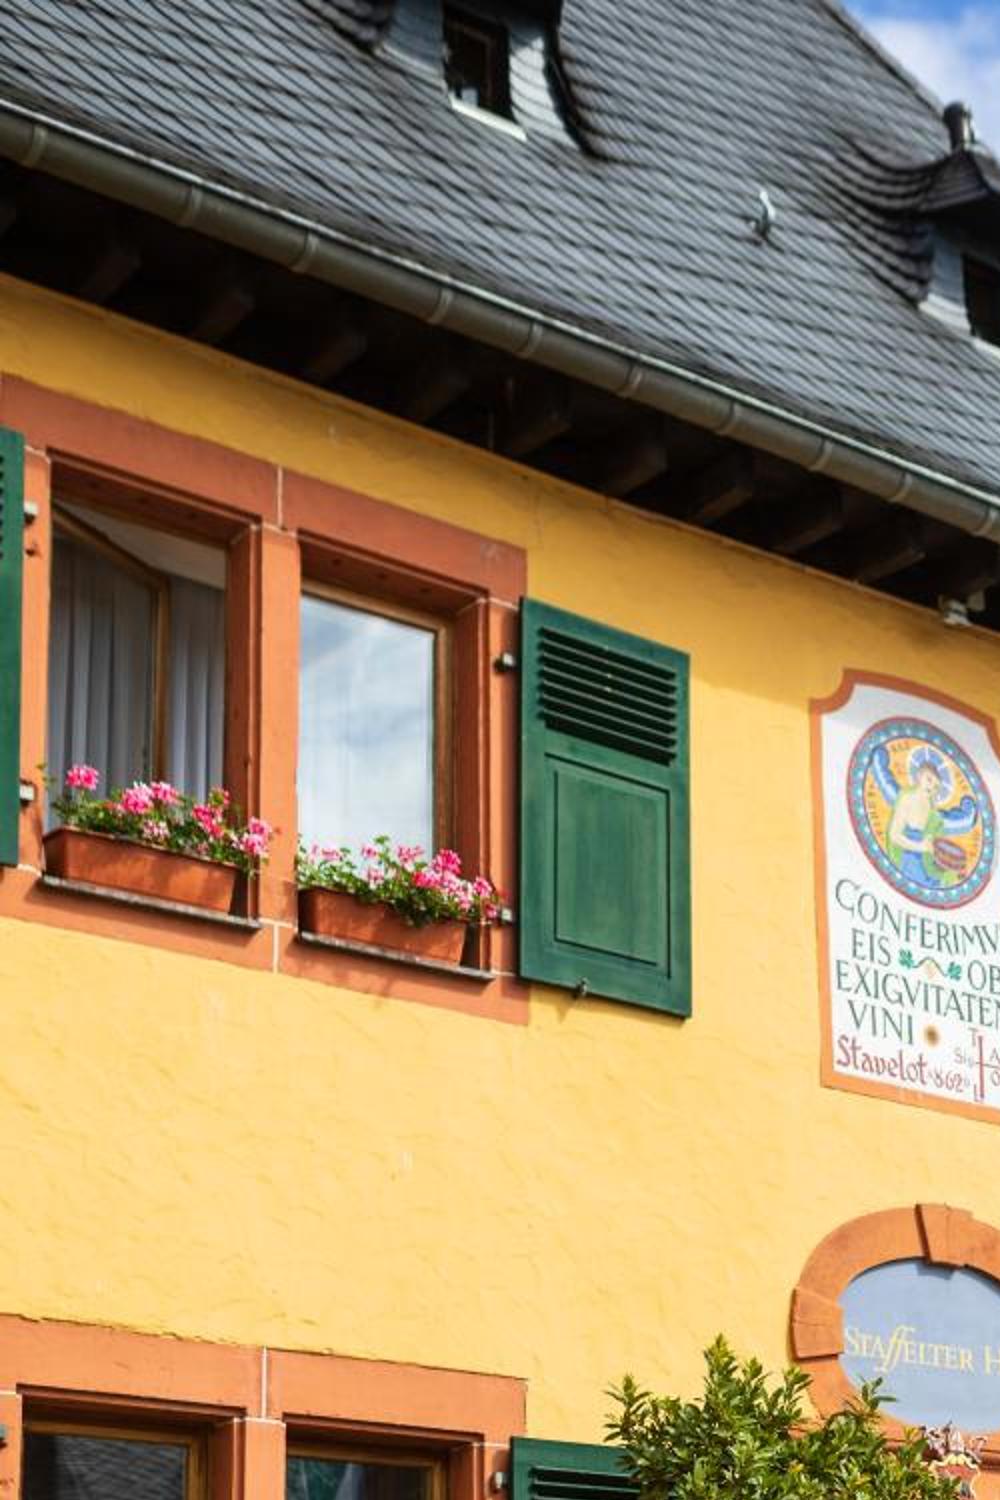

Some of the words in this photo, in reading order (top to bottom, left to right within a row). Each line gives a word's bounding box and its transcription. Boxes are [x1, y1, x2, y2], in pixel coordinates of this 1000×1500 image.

[851, 928, 891, 967] EIS
[848, 1000, 914, 1045] VINI
[836, 1034, 928, 1085] Stavelot
